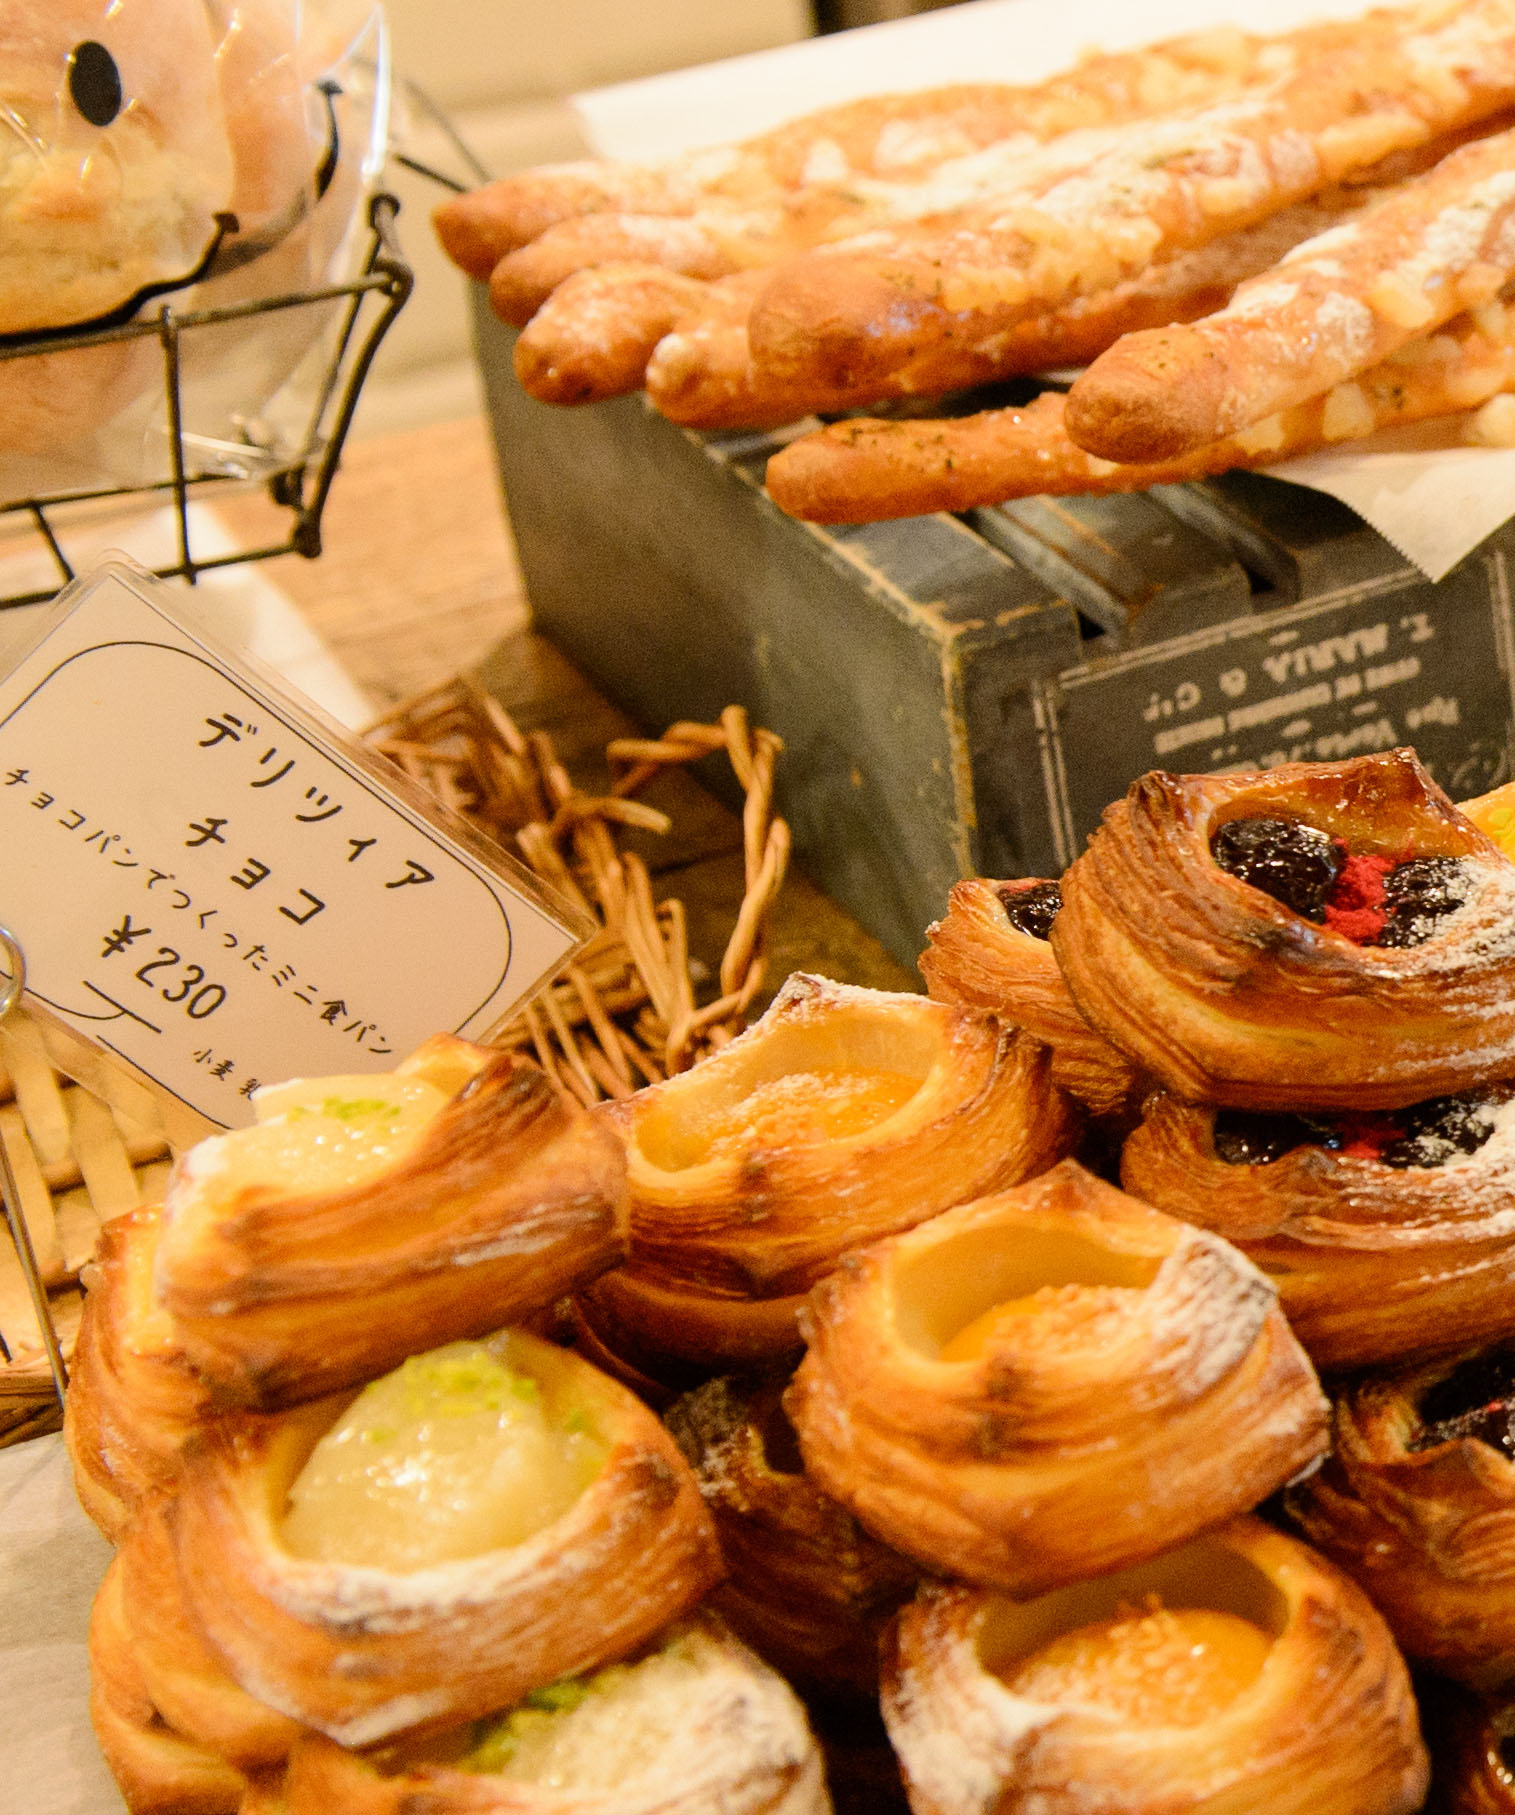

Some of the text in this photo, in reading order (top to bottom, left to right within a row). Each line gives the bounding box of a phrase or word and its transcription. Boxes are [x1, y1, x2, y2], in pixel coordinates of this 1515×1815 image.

[186, 818, 326, 925] チョコ
[199, 713, 435, 889] デリツィア
[5, 769, 393, 1055] チョコパンでつくったミニ食パン
[102, 915, 227, 1020] ¥230
